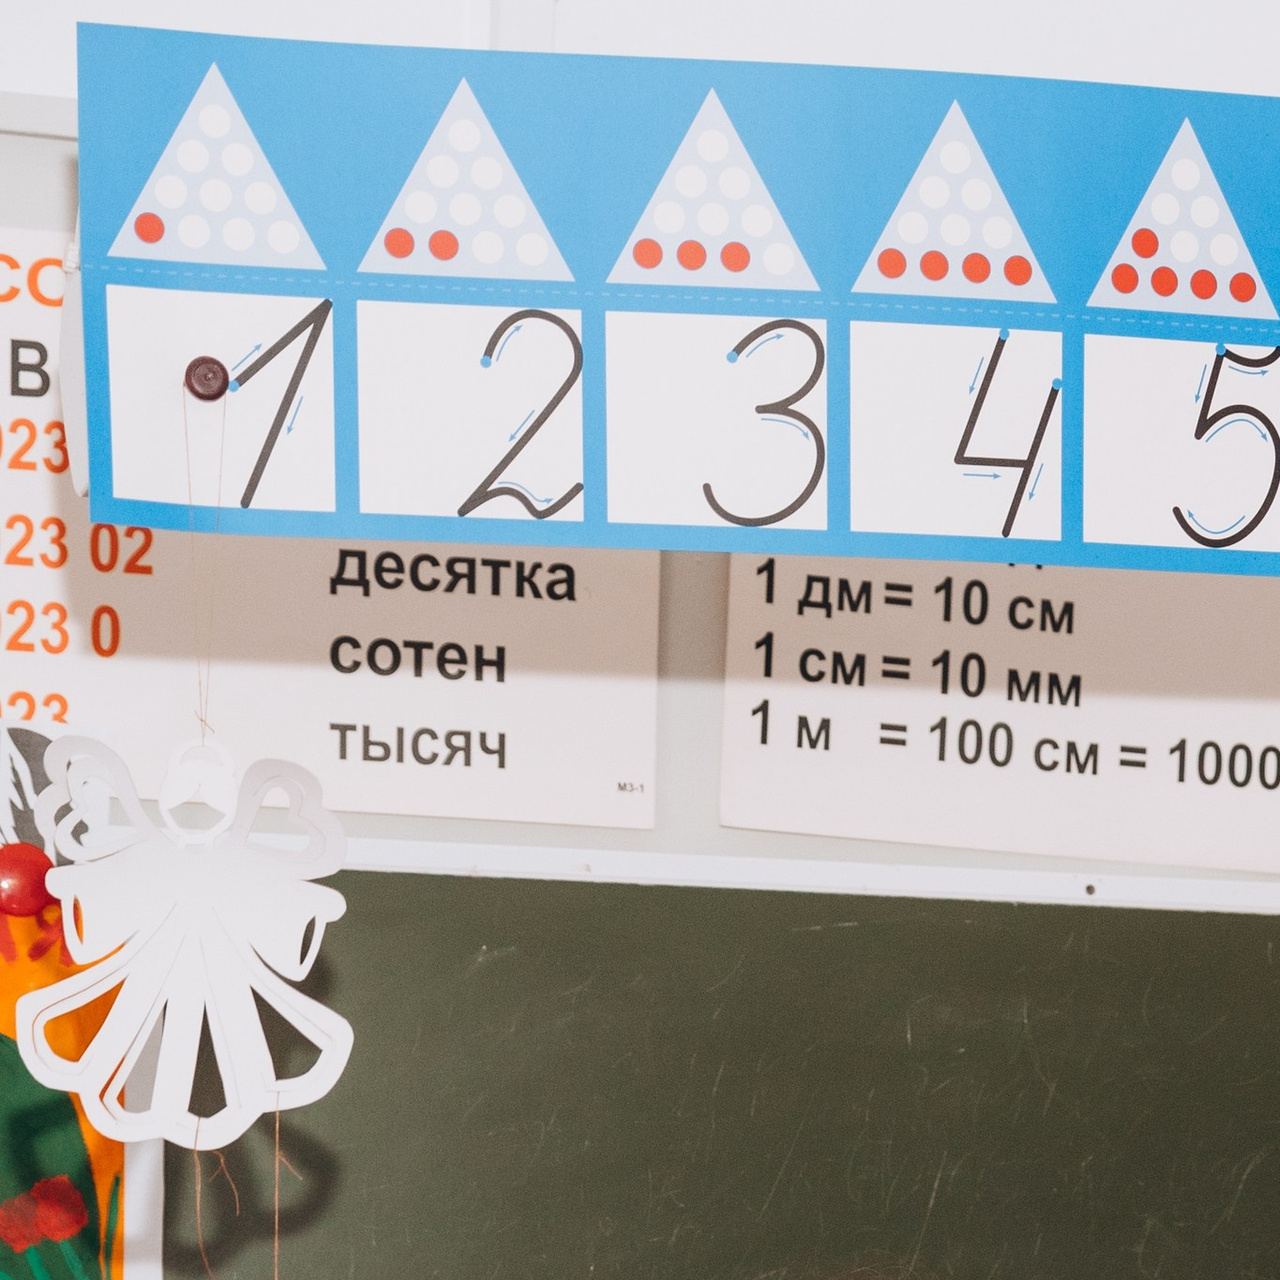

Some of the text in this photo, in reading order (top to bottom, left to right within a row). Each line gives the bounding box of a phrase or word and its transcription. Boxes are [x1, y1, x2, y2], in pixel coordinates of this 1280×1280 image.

[0, 418, 71, 475] 23
[228, 299, 333, 509] 1
[458, 308, 585, 519] 2
[703, 318, 826, 527] 3
[954, 329, 1063, 539] 4
[89, 523, 155, 577] 02
[329, 548, 578, 602] десятка
[756, 557, 1075, 635] 1 дм = 10 см
[0, 599, 122, 659] 23 0
[329, 635, 507, 683] сотен
[754, 631, 1082, 707] 1 см = 10 мм
[329, 723, 507, 769] тысяч
[751, 699, 769, 745] 1
[797, 716, 832, 751] м
[879, 723, 908, 746] =
[929, 717, 1014, 768] 100
[1034, 739, 1099, 775] см
[1119, 745, 1147, 769] =
